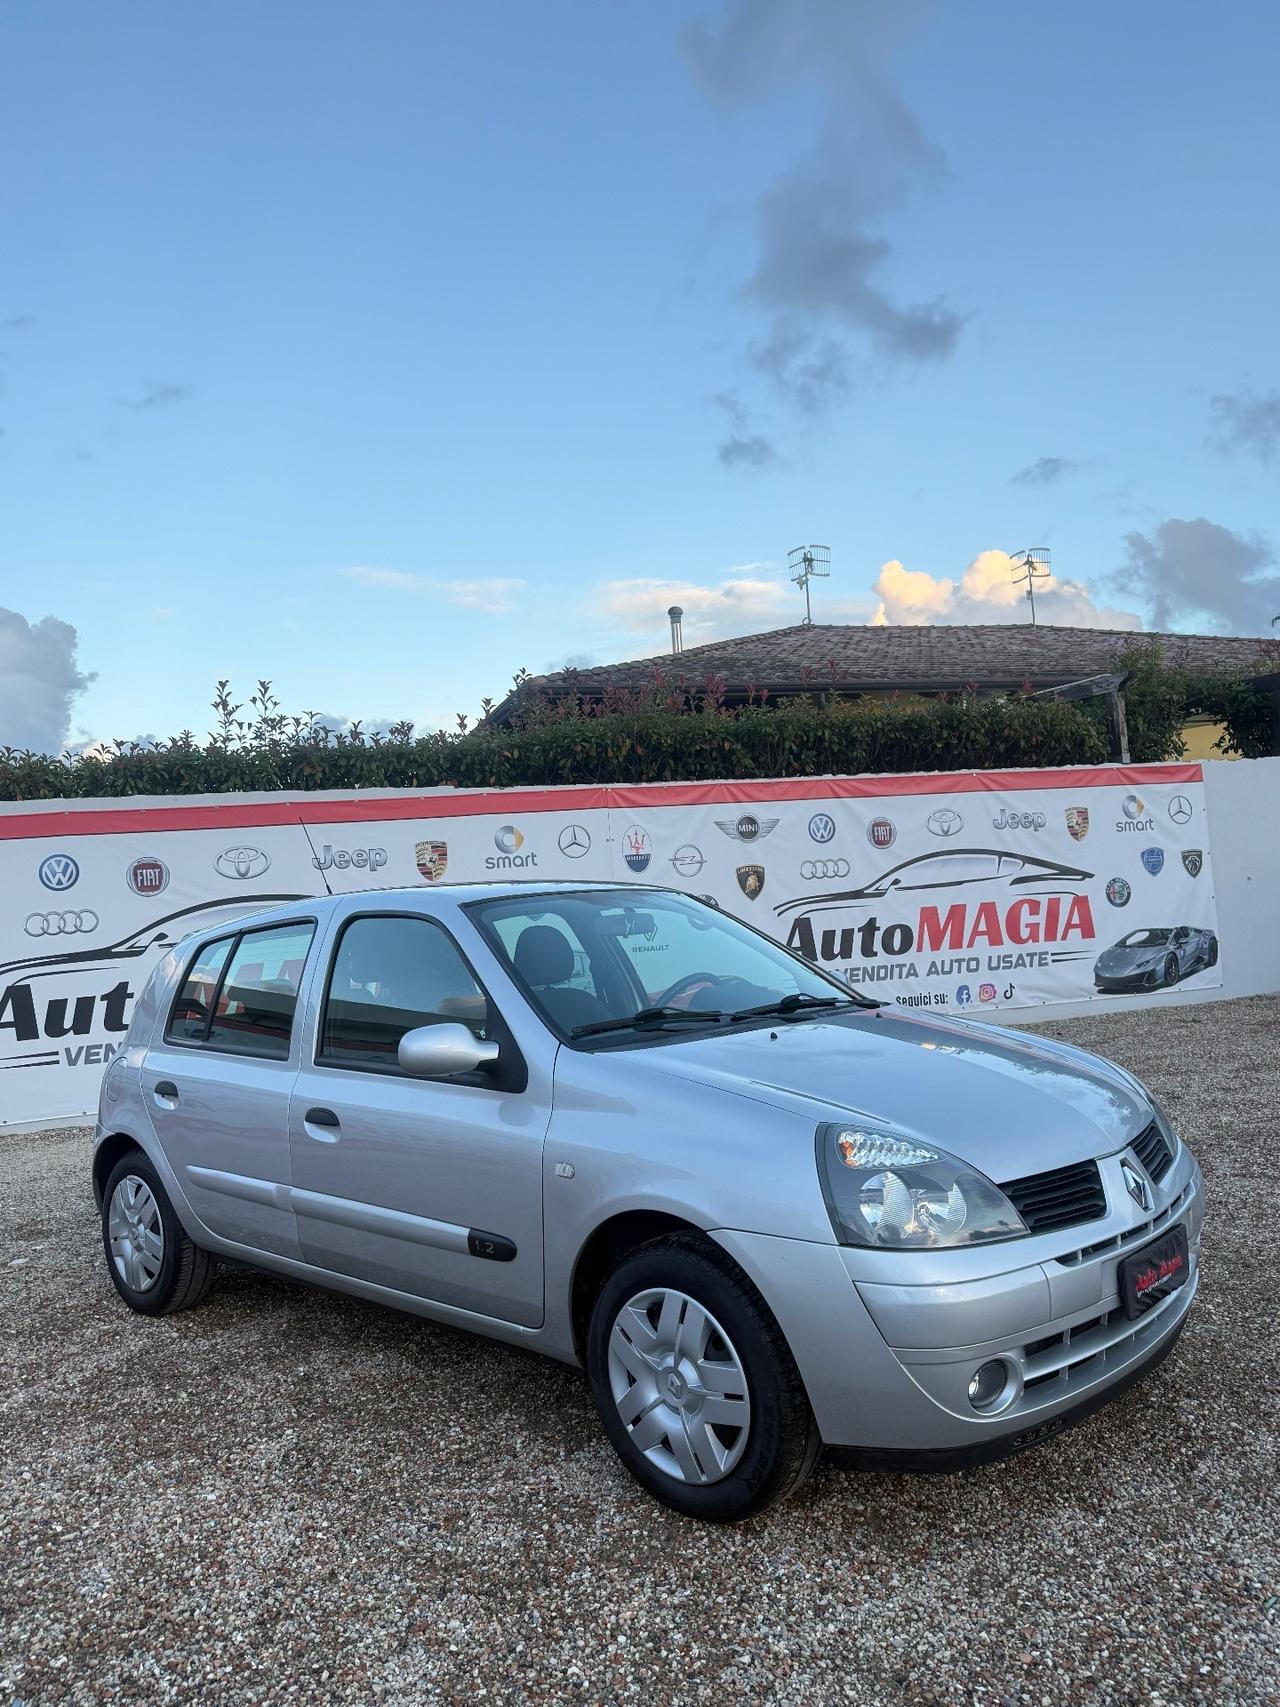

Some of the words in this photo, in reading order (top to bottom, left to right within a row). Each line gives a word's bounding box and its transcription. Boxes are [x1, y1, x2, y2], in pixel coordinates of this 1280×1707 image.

[737, 823, 759, 834] MINI
[992, 809, 1047, 832] Jeep
[1116, 818, 1155, 833] smart
[874, 827, 891, 841] FIAT
[312, 845, 389, 872] Jeep
[485, 852, 538, 870] smart
[136, 868, 161, 887] FIAT
[632, 944, 671, 954] RENAULT
[835, 961, 919, 984] ENDITA
[926, 956, 980, 977] AUTO
[988, 951, 1050, 971] USATE
[934, 993, 949, 1005] su:
[0, 981, 135, 1041] Aut
